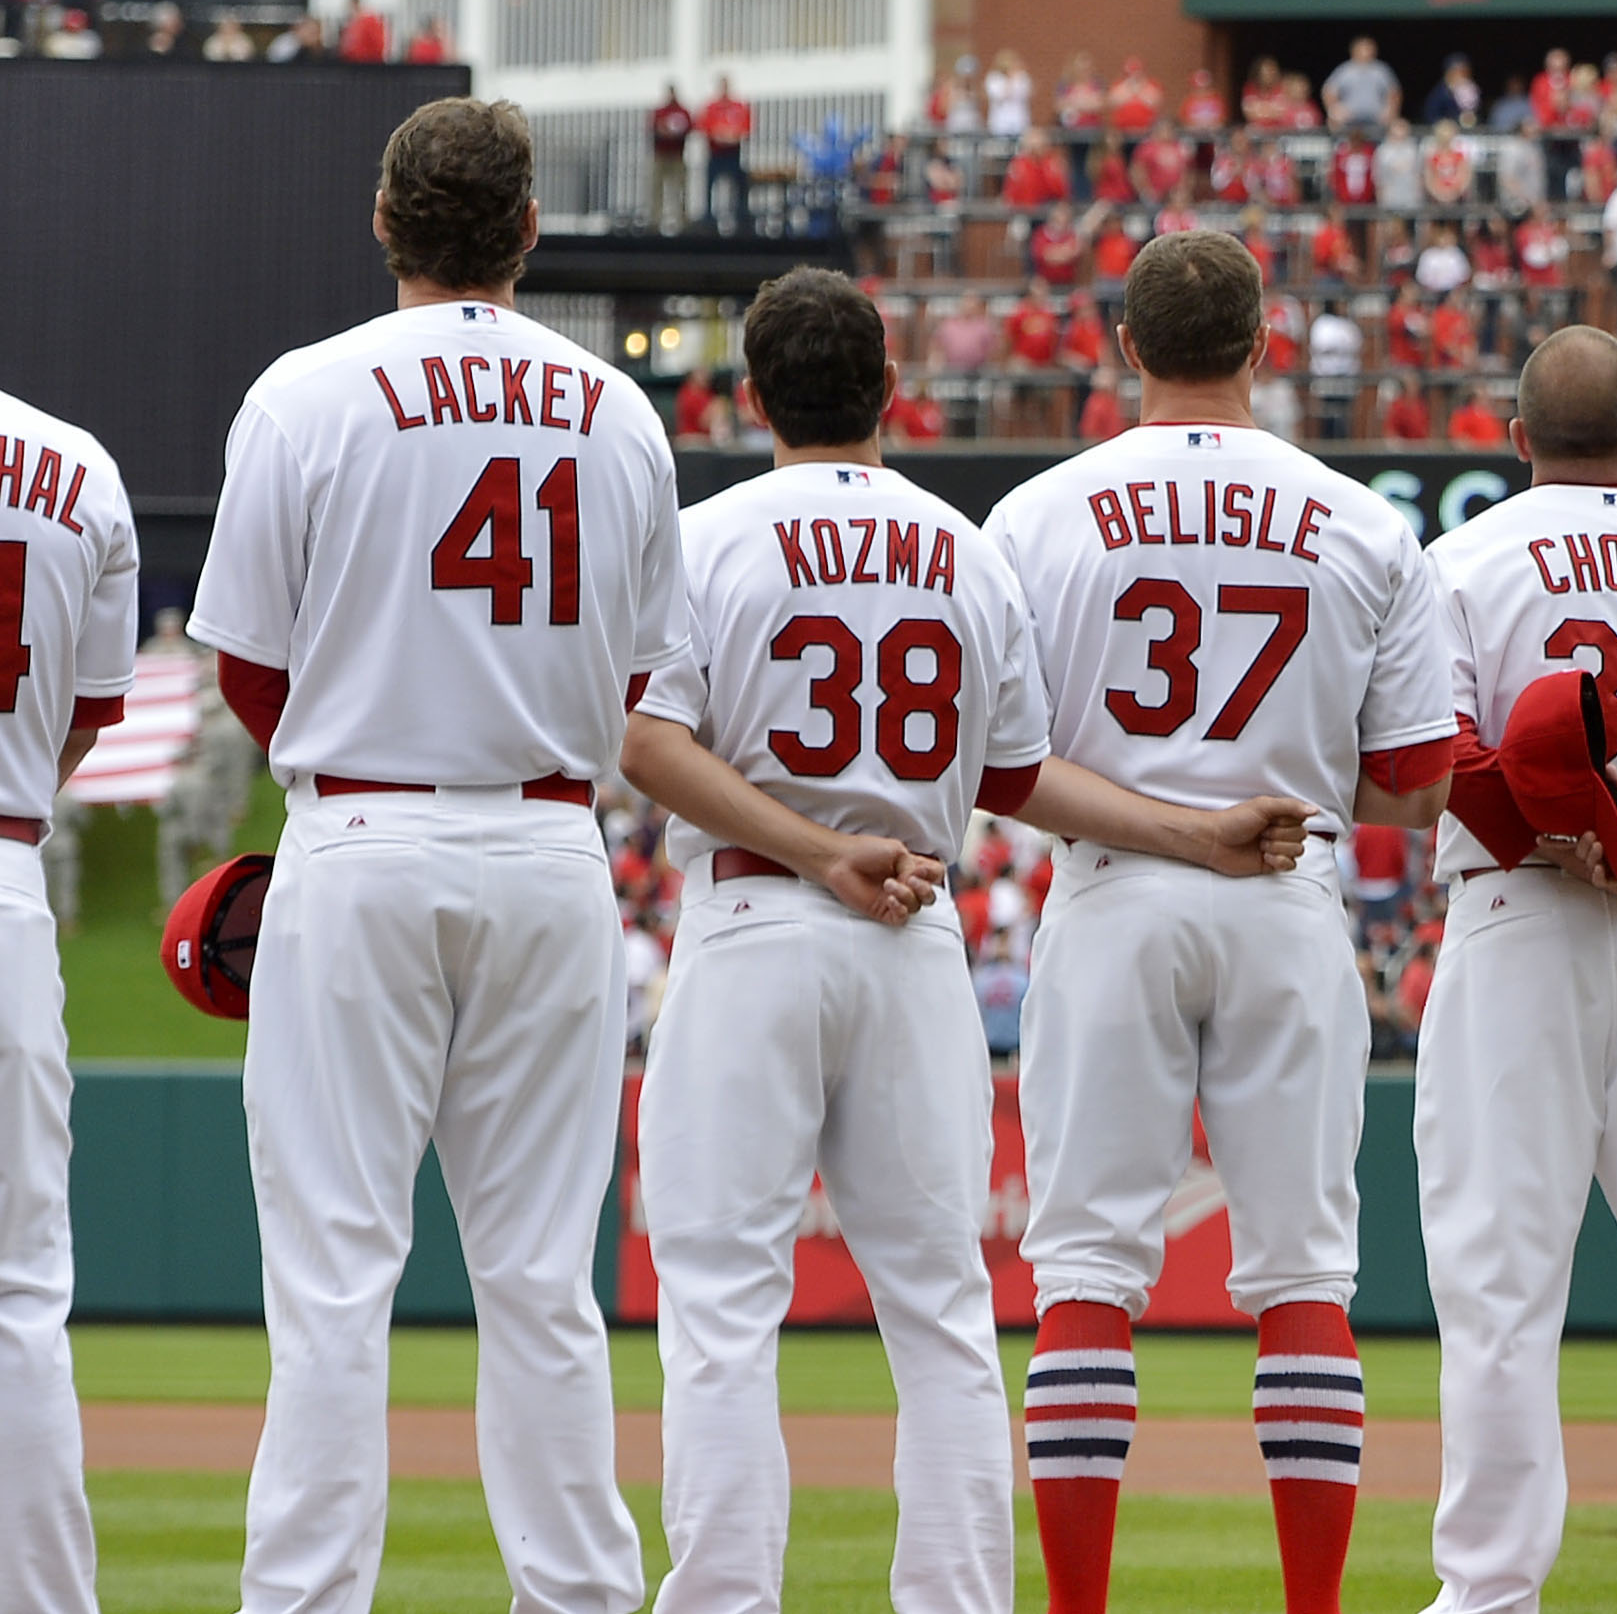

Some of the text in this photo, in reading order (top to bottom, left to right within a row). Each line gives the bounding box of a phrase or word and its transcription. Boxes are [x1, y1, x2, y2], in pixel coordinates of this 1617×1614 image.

[372, 355, 604, 435] LACKEY
[431, 457, 580, 626] 41
[774, 517, 955, 595] KOZMA
[1088, 480, 1332, 564] BELISLE
[767, 615, 962, 782] 38
[1105, 577, 1309, 741] 37
